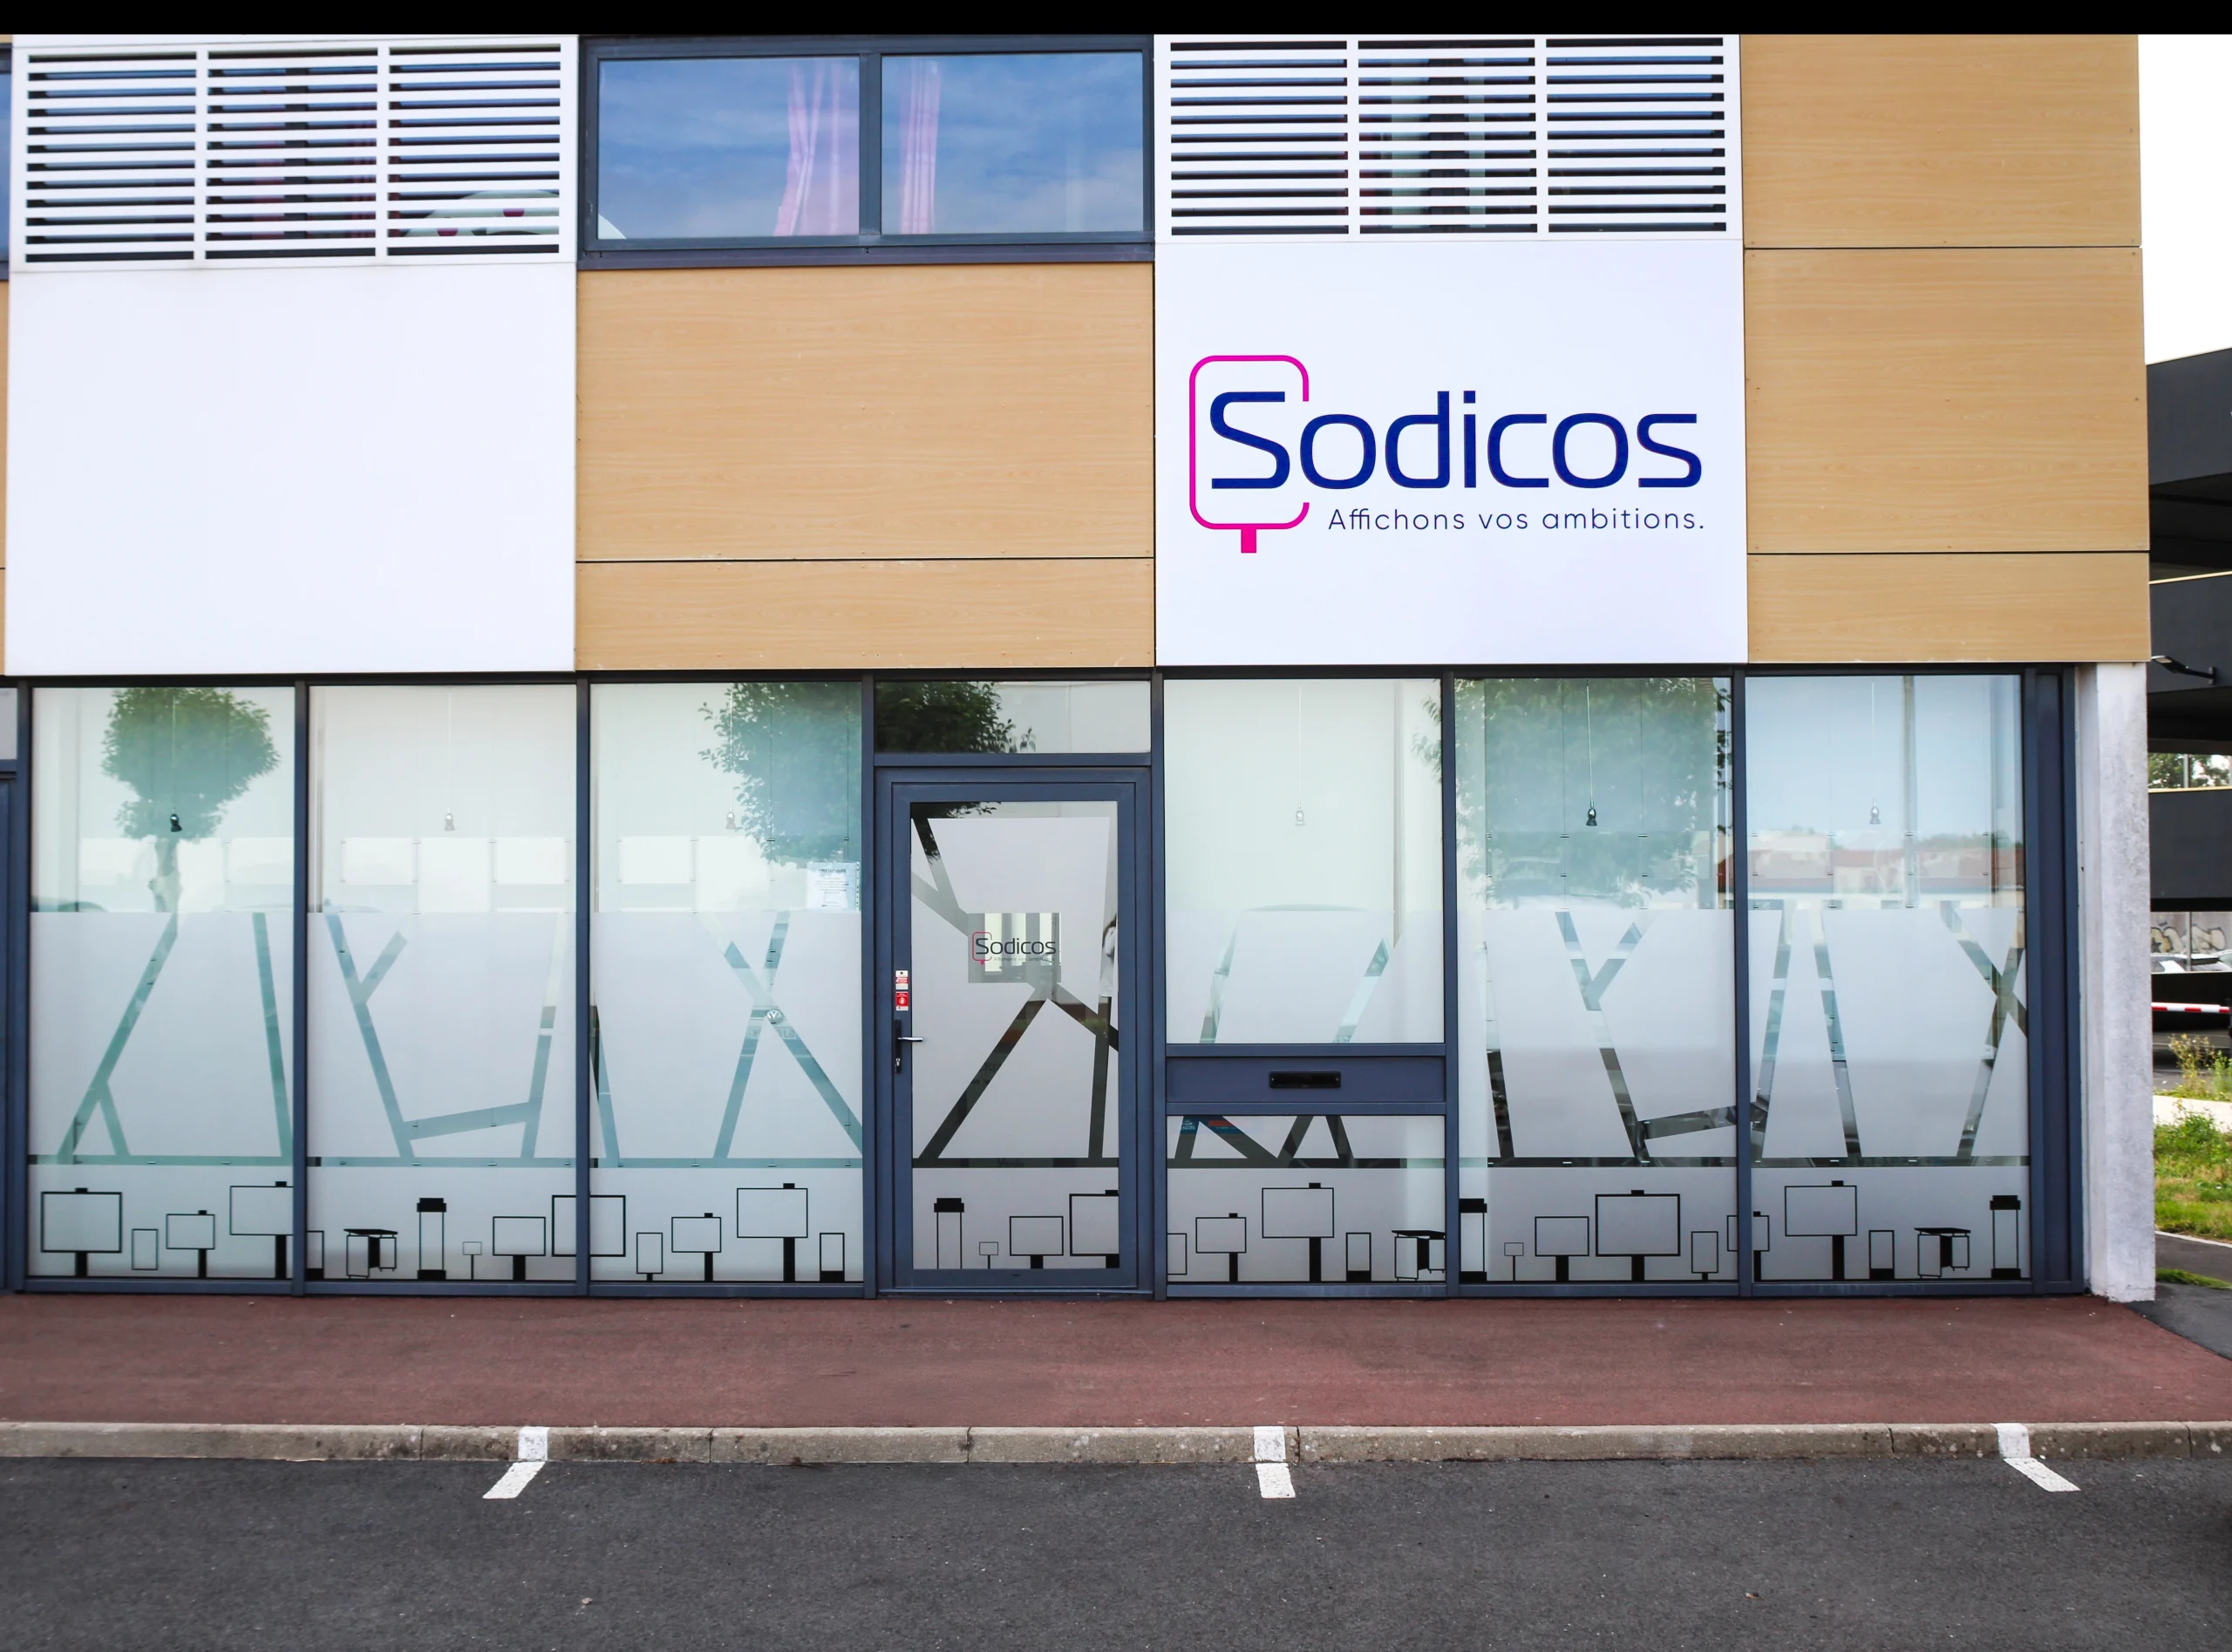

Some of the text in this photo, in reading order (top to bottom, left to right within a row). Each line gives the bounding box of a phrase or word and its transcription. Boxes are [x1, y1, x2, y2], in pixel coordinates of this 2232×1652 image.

[1209, 390, 1702, 490] Sodicos
[1328, 507, 1705, 531] Affichons vos ambitions.
[975, 937, 1057, 955] Sodicos
